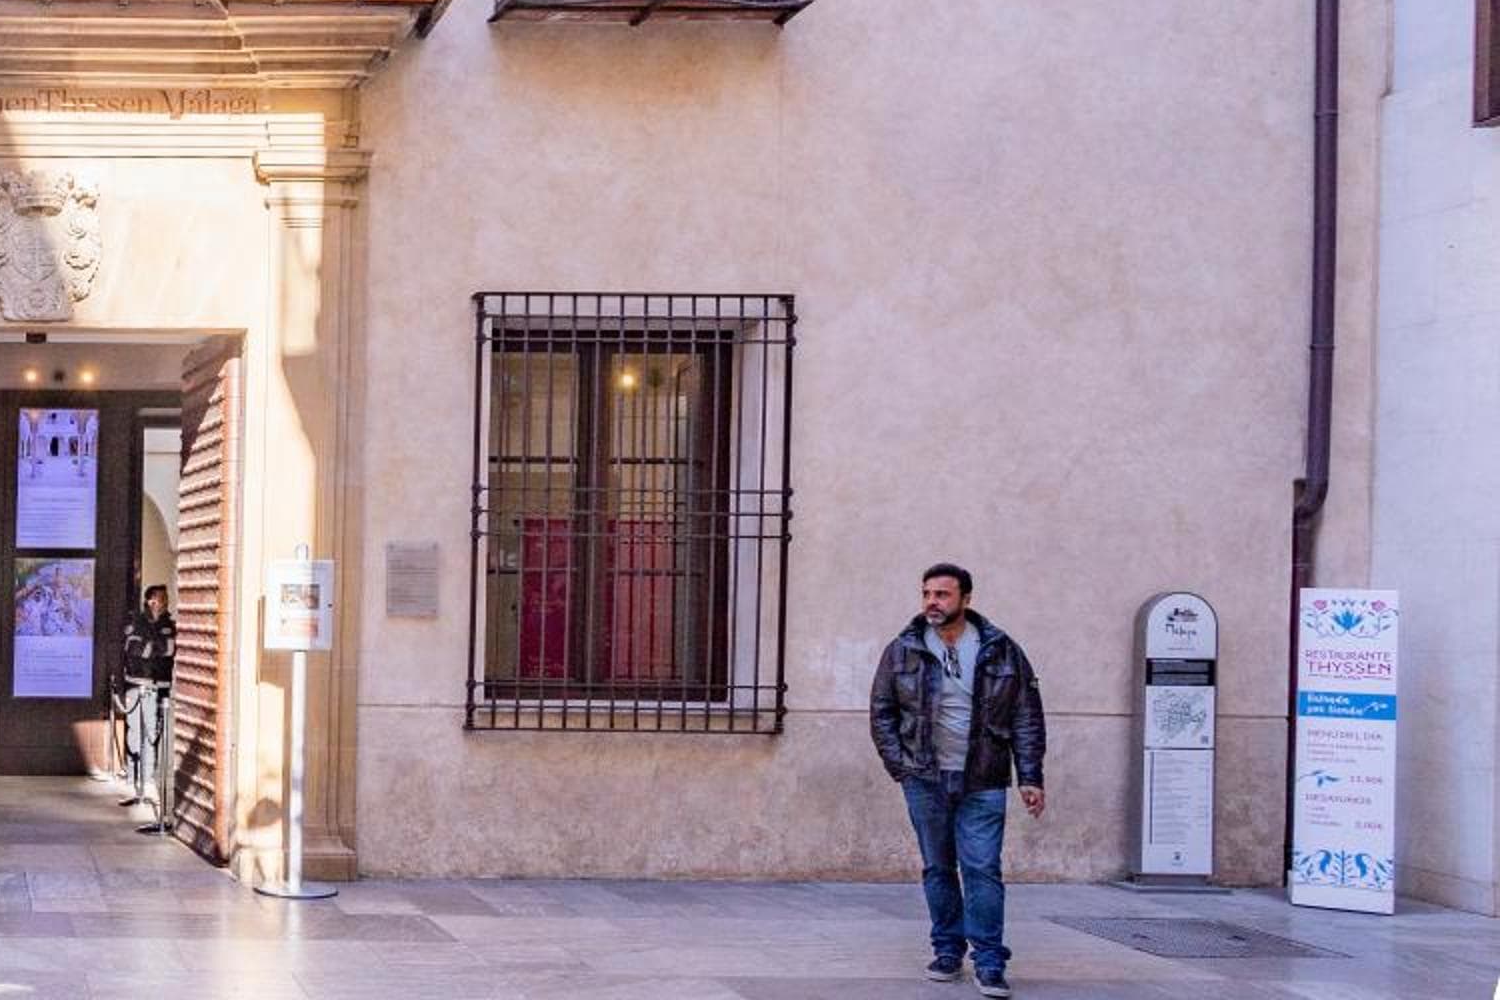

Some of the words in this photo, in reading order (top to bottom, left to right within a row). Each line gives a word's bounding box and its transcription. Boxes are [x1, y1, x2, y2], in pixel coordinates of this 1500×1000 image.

[38, 88, 151, 113] Thyssen
[1305, 649, 1392, 662] RESTAURANTE
[1306, 660, 1392, 676] THYSSEN
